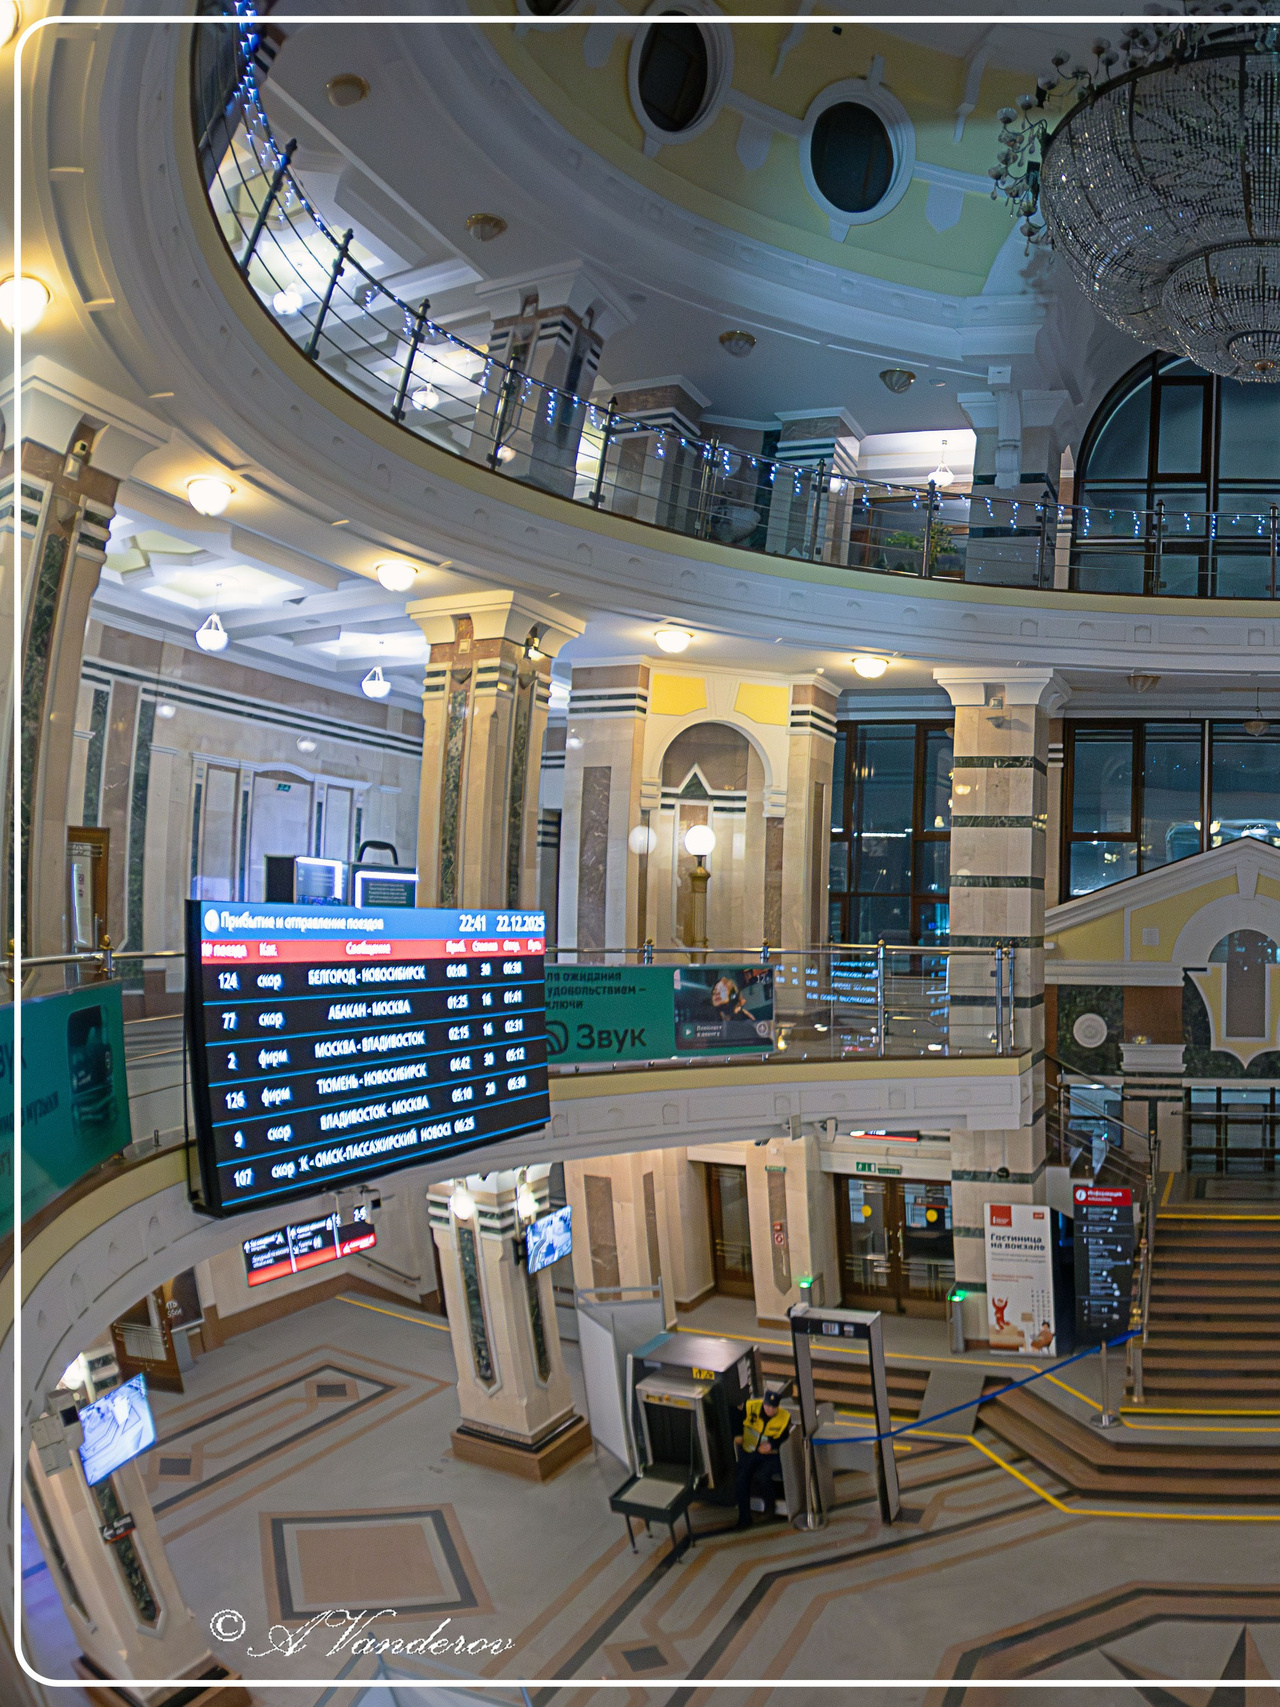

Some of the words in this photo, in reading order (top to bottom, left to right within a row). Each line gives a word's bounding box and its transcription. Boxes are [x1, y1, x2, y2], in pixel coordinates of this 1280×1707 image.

[459, 914, 486, 932] 22:41
[496, 914, 545, 932] 22.12.2025
[218, 972, 238, 989] 124
[257, 974, 282, 991] скор
[308, 968, 357, 986] БЕЛГОРОД
[361, 965, 425, 982] НОВОСИБИРСК
[481, 963, 491, 976] 30
[548, 985, 636, 998] удовольствием
[562, 972, 622, 982] ожидания
[222, 1012, 236, 1029] 77
[259, 1012, 284, 1029] скор
[328, 1003, 367, 1020] АБАКАН
[372, 999, 411, 1016] МОСКВА
[448, 994, 468, 1009] 01:25
[482, 993, 492, 1006] 16
[227, 1052, 237, 1070] 2
[259, 1049, 288, 1069] фирм
[315, 1039, 357, 1058] МОСКВА
[362, 1031, 426, 1052] ВЛАДИВОСТОК
[449, 1025, 469, 1040] 02:15
[483, 1022, 493, 1035] 16
[576, 1023, 647, 1053] Звук
[226, 1091, 245, 1109] 126
[261, 1087, 291, 1107] фирм
[317, 1074, 359, 1094] ТЮМЕНЬ
[364, 1063, 427, 1086] НОВОСИБИРСК
[450, 1056, 470, 1072] 04:42
[484, 1052, 494, 1066] 30
[506, 1047, 525, 1062] 05:12
[234, 1130, 244, 1148] 9
[268, 1125, 293, 1141] скор
[320, 1103, 388, 1130] ВЛАДИВОСТОК
[392, 1095, 430, 1115] МОСКВА
[452, 1086, 473, 1102] 05:10
[486, 1082, 496, 1096] 20
[508, 1075, 527, 1090] 05:30
[234, 1168, 253, 1188] 107
[272, 1162, 296, 1178] скор
[454, 1116, 475, 1133] 06:25
[990, 1233, 1043, 1244] Гостиница
[990, 1242, 1003, 1250] на
[1004, 1242, 1045, 1252] вокзале
